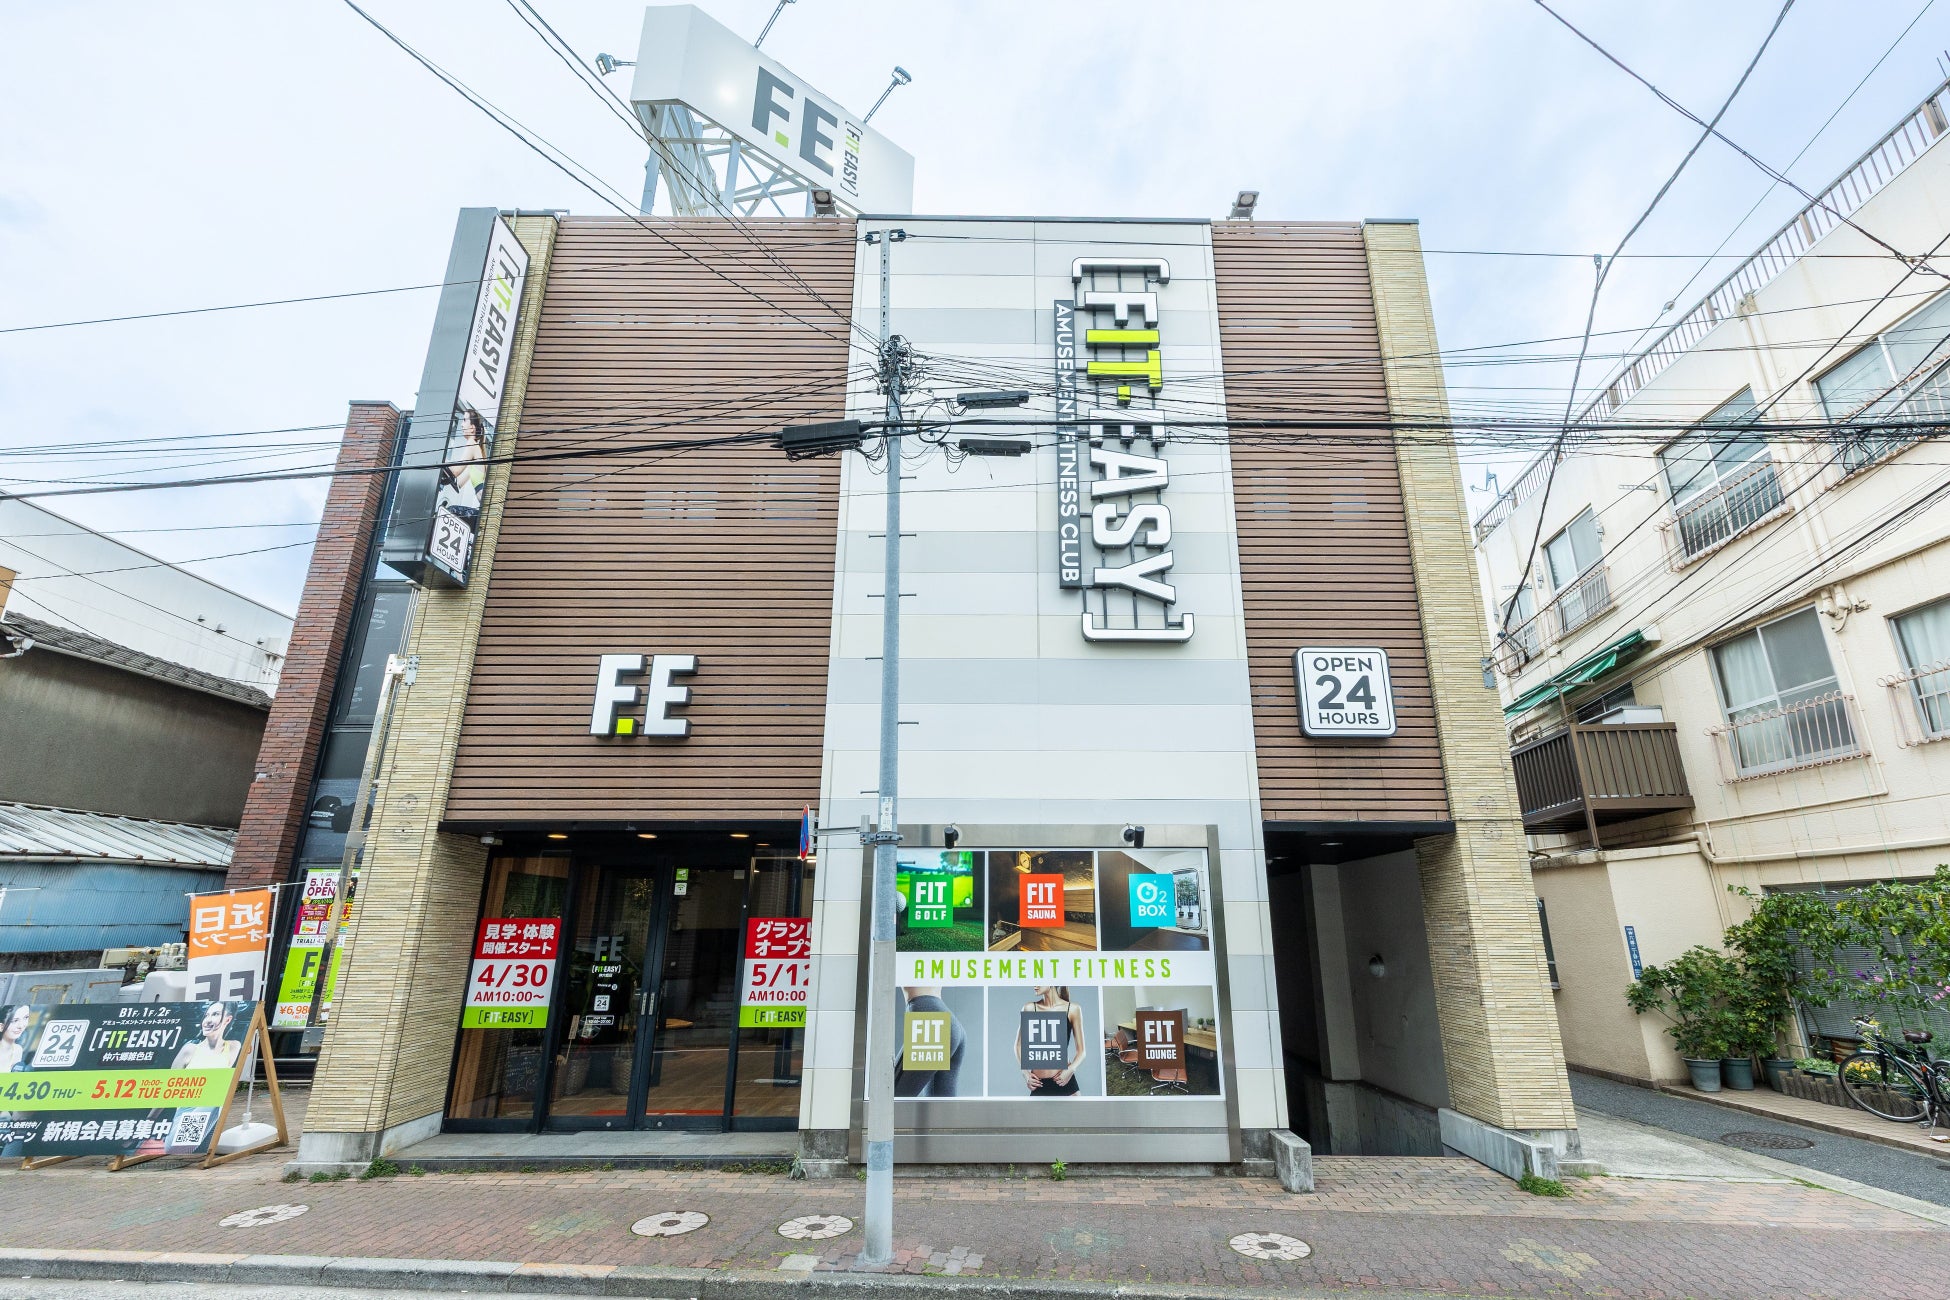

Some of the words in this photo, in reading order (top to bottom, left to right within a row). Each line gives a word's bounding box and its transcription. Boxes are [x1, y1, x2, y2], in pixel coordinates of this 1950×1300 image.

[1056, 303, 1077, 424] AMUSEMENT
[1059, 431, 1078, 517] FITNESS
[442, 516, 466, 535] OPEN
[438, 527, 462, 556] 24
[436, 546, 459, 565] HOURS
[1061, 523, 1080, 582] CLUB
[1313, 656, 1374, 672] OPEN
[1315, 674, 1377, 710] 24
[1318, 712, 1380, 725] HOURS
[307, 886, 336, 897] OPEN
[916, 882, 947, 902] FIT
[1027, 883, 1056, 903] FIT
[915, 910, 947, 920] GOLF
[1027, 909, 1057, 920] SAUNA
[1138, 905, 1168, 917] BOX
[485, 923, 556, 941] 見学・体験
[482, 942, 552, 955] 開催スタート
[477, 964, 548, 988] 4/30
[914, 959, 1060, 980] AMUSEMENT
[1073, 958, 1172, 979] FITNESS
[51, 1024, 82, 1034] OPEN
[911, 1019, 944, 1043] FIT
[1028, 1019, 1060, 1043] FIT
[1144, 1020, 1175, 1043] FIT
[43, 1034, 76, 1055] 24
[39, 1055, 71, 1063] HOURS
[911, 1051, 944, 1062] CHAIR
[1028, 1050, 1061, 1061] SHAPE
[1145, 1049, 1177, 1060] LOUNGE
[4, 1081, 51, 1101] 4.30
[91, 1079, 137, 1099] 5.12
[167, 1076, 207, 1088] GRAND
[138, 1088, 162, 1099] TUE
[163, 1088, 203, 1099] OPEN!!
[42, 1119, 173, 1142] 新規会員募集中
